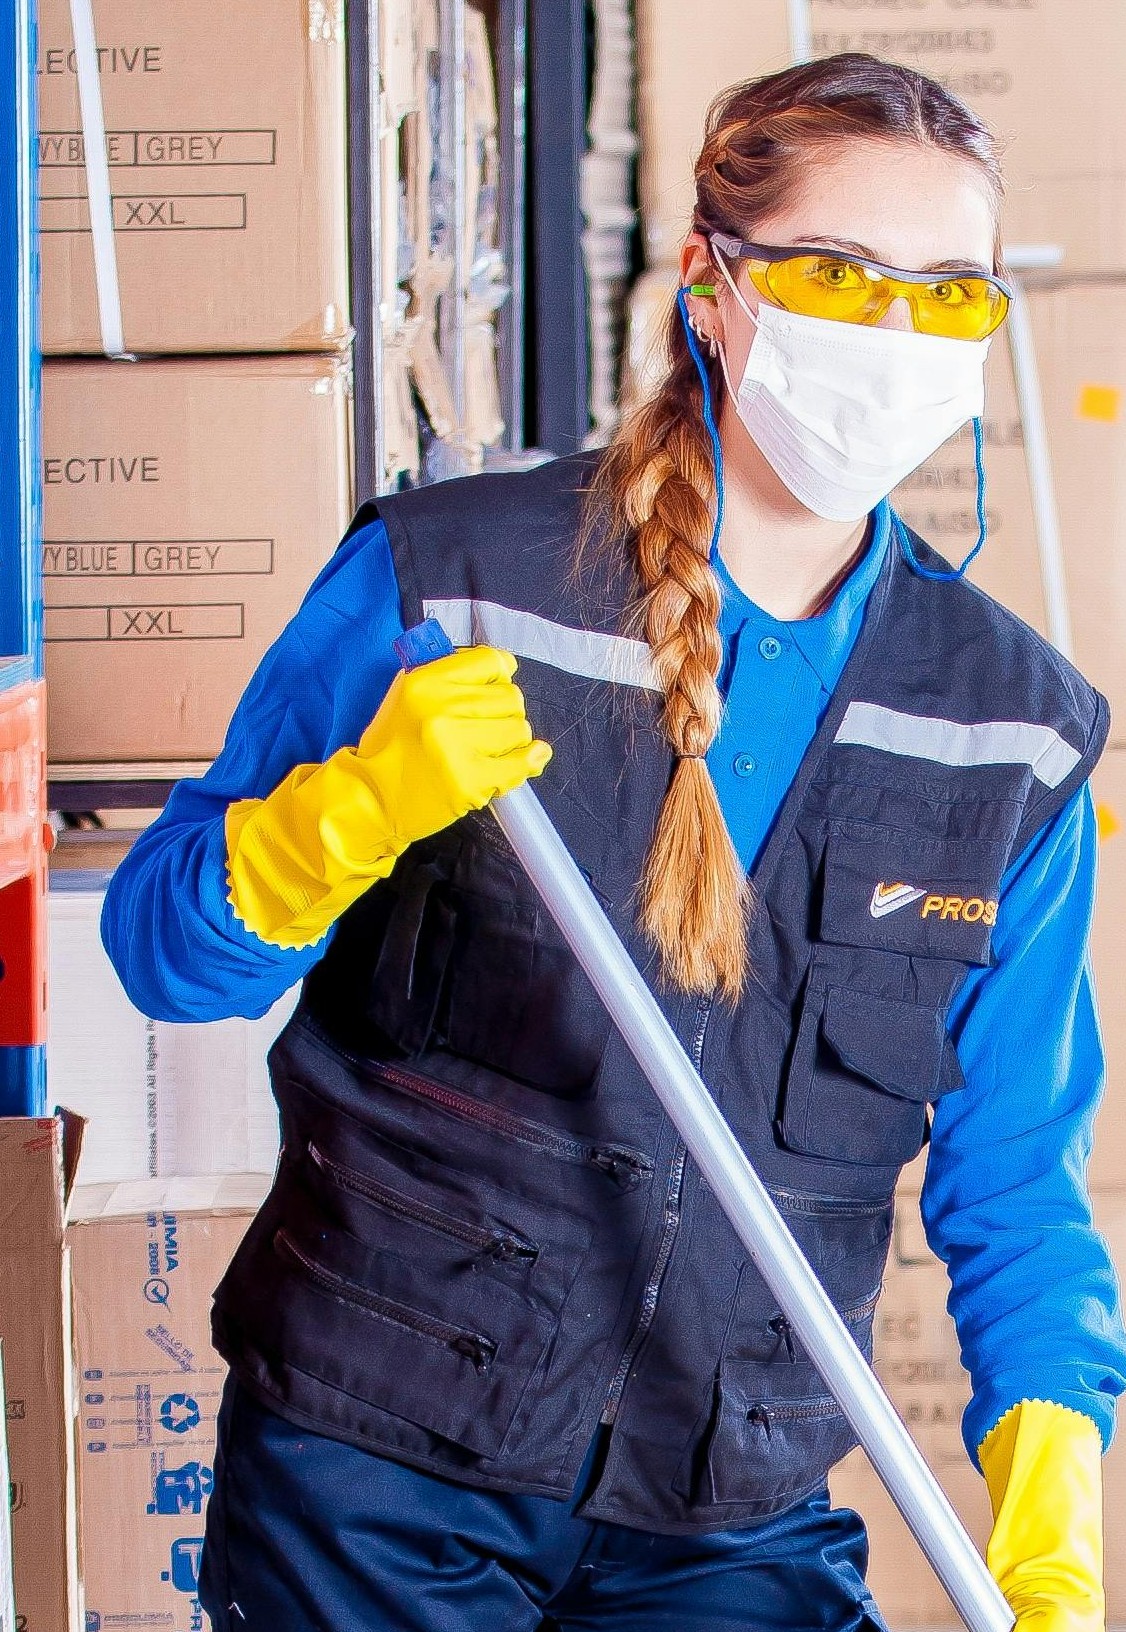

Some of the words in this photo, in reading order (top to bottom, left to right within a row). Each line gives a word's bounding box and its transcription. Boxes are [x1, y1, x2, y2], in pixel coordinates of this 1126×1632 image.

[146, 136, 223, 161] GREY
[126, 202, 186, 226] XXL
[144, 545, 222, 571] GREY
[122, 610, 183, 635] XXL
